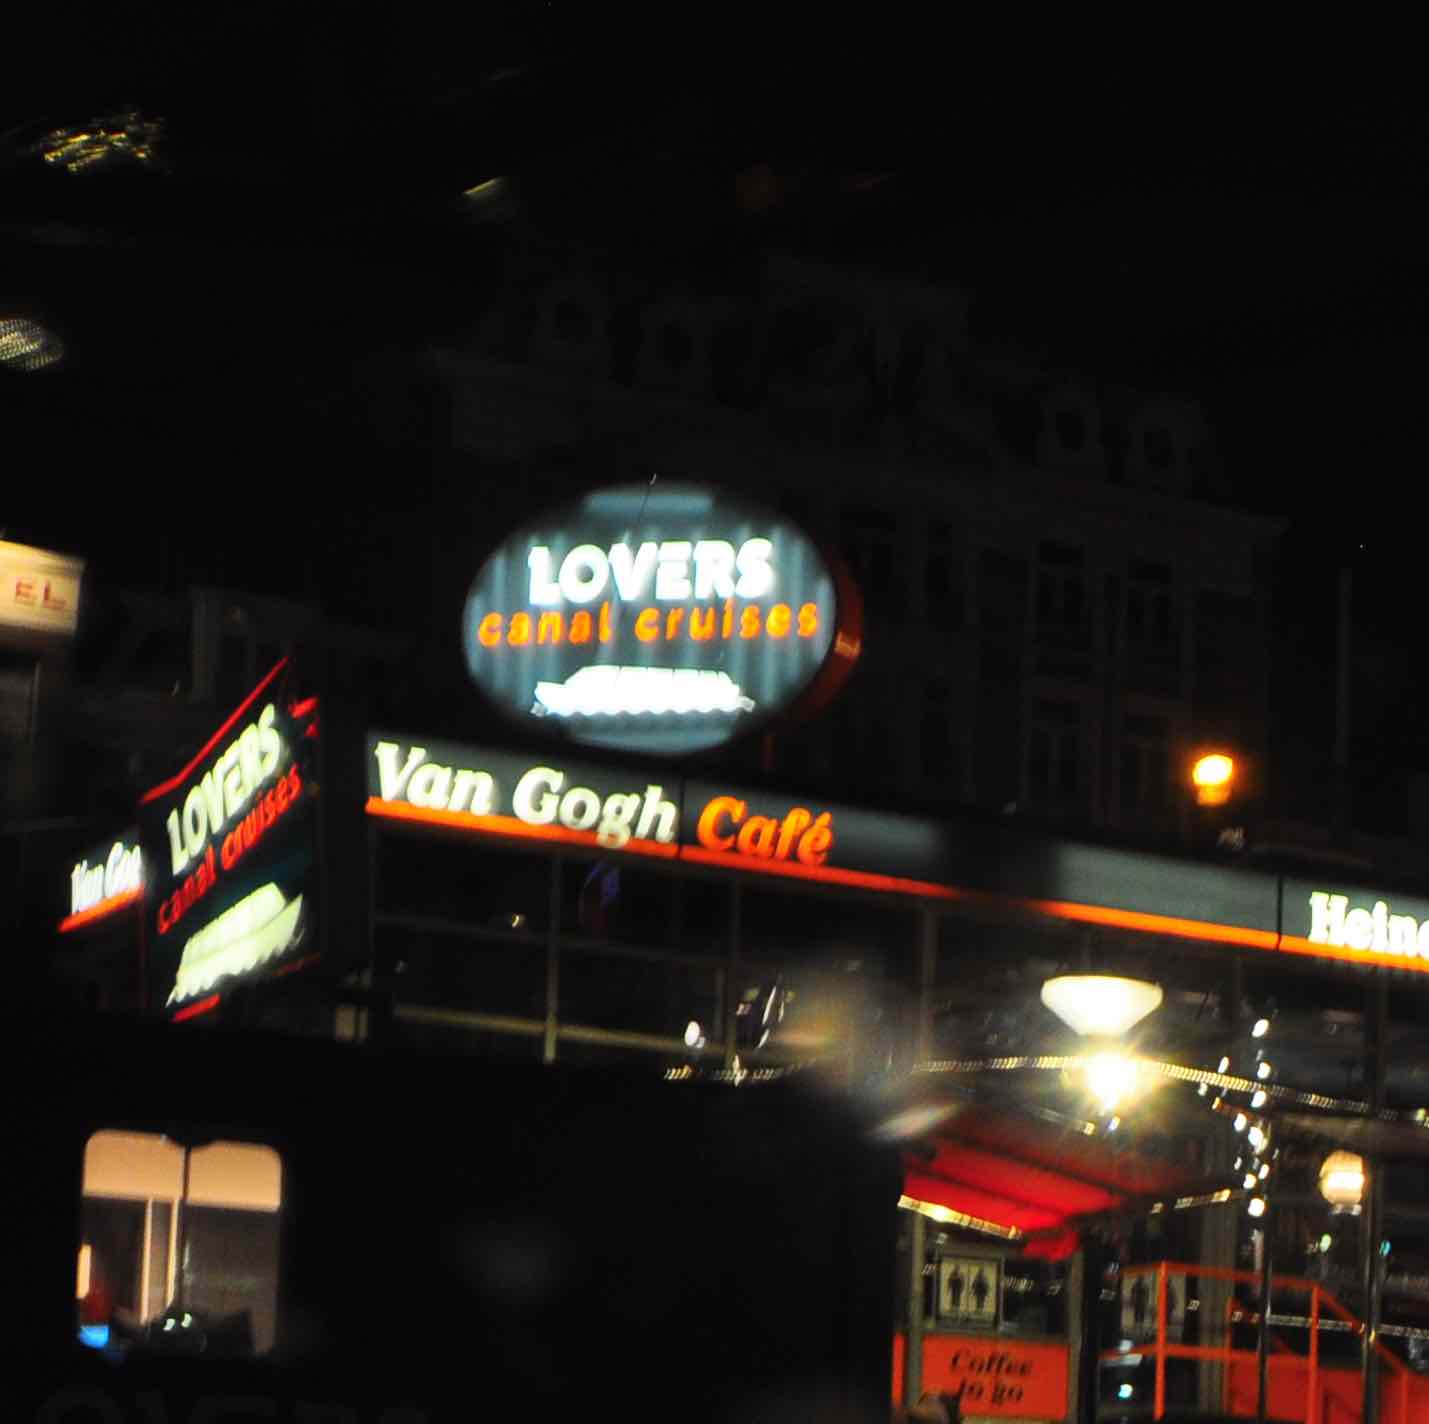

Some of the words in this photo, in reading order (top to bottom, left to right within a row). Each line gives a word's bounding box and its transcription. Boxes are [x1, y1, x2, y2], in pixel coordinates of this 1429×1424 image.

[527, 538, 774, 606] LOVERS
[478, 601, 614, 647] canal
[634, 597, 818, 643] cruises
[166, 702, 281, 877] LOVERS
[374, 741, 496, 817] Van
[512, 766, 678, 849] Gogh
[697, 796, 834, 866] Café
[158, 843, 217, 936] canal
[220, 763, 302, 871] cruises
[951, 1349, 1033, 1377] Coffee
